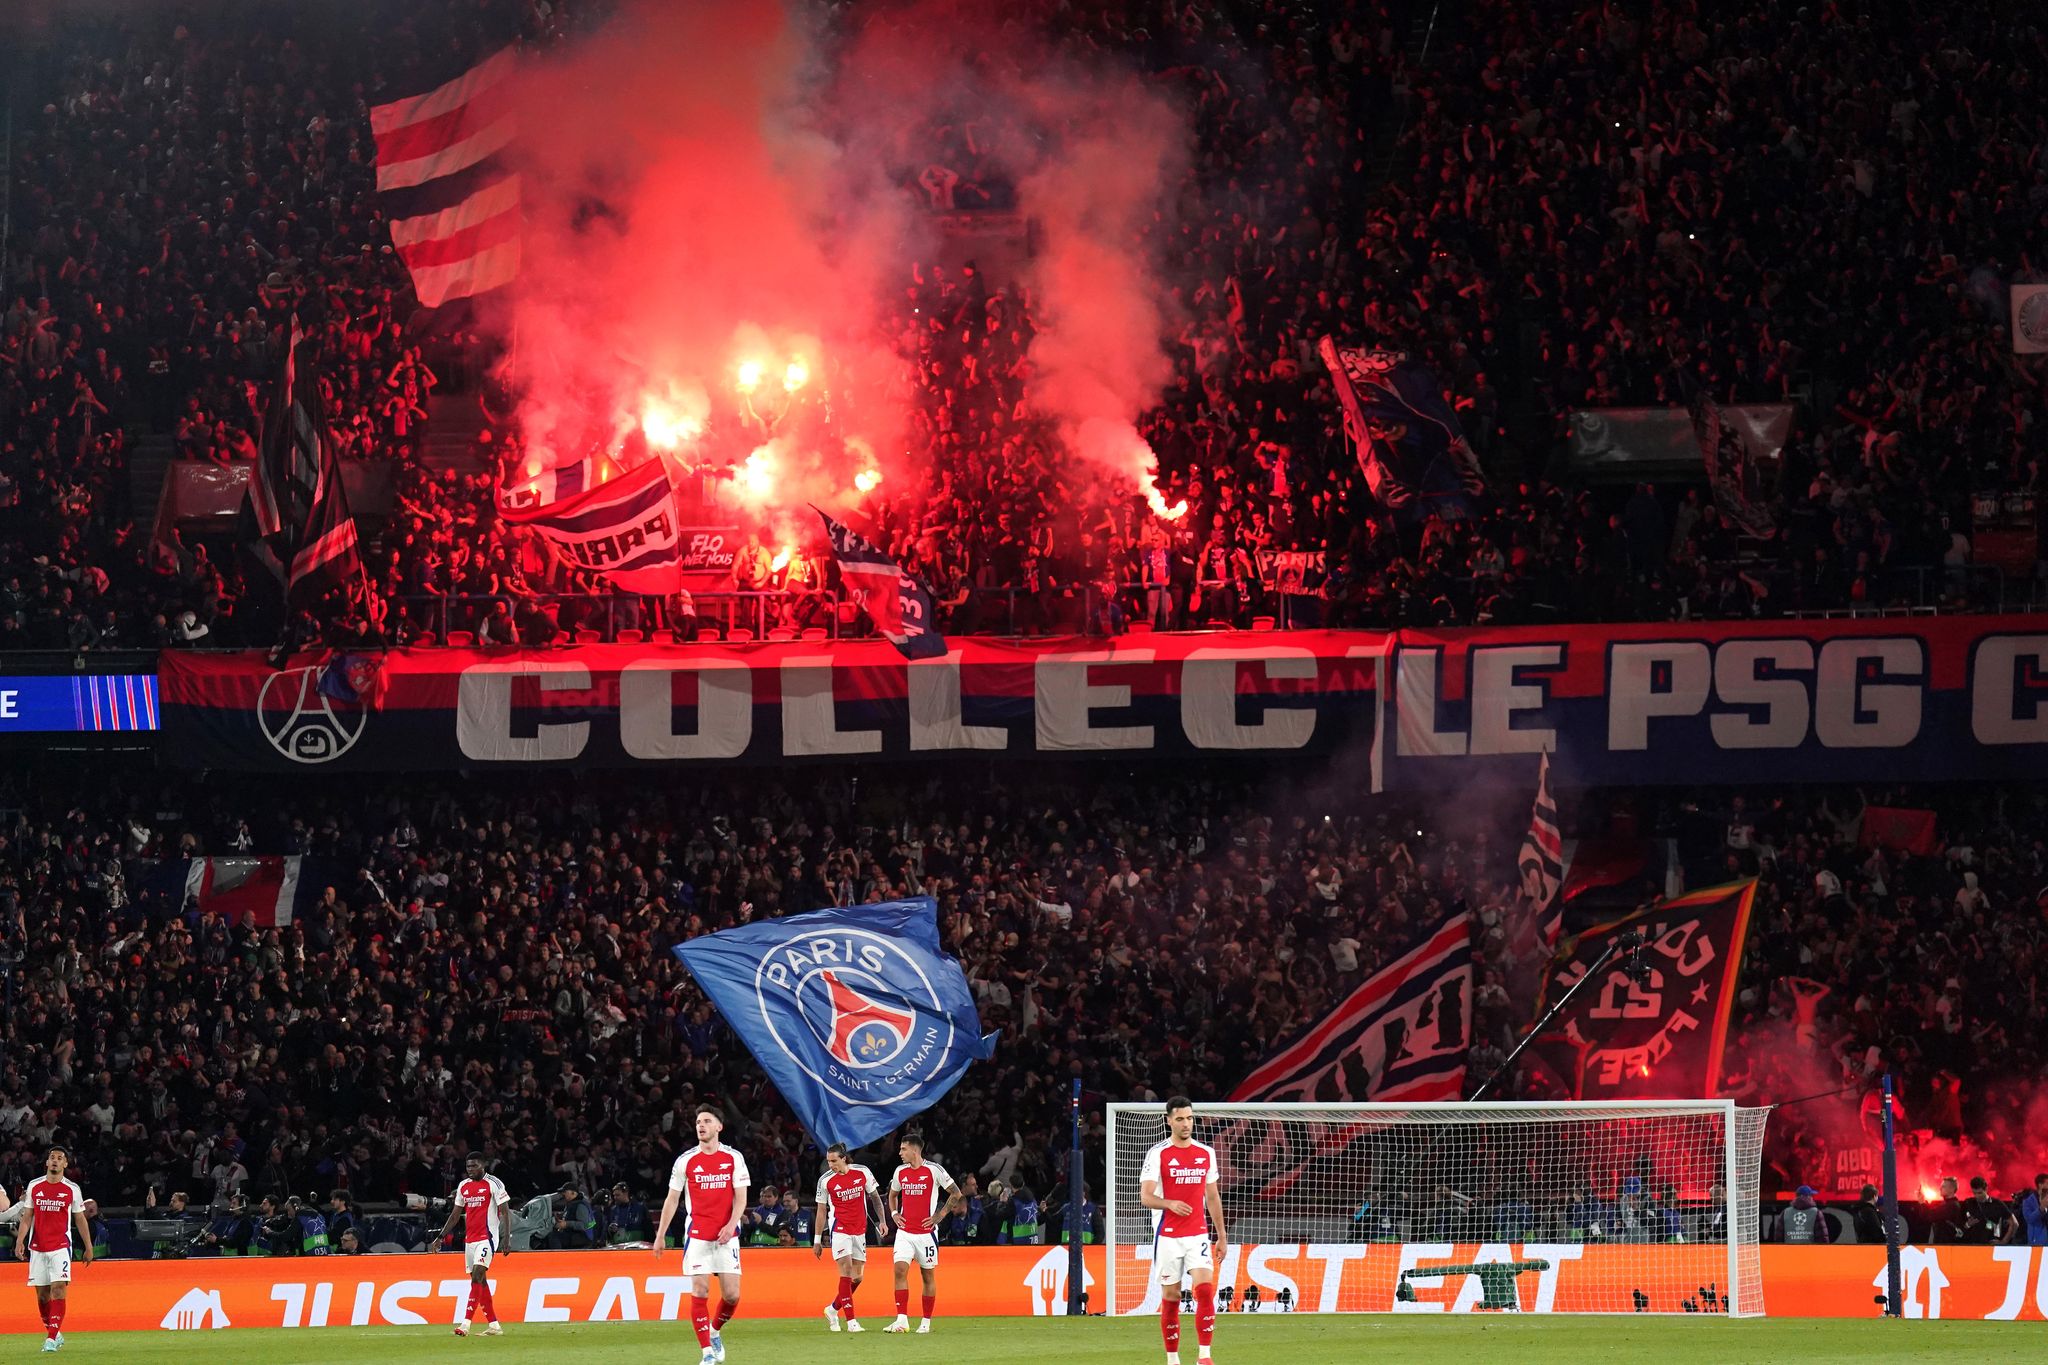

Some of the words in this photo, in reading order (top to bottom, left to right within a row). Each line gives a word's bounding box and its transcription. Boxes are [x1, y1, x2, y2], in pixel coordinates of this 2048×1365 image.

[690, 534, 724, 553] FLO
[705, 552, 734, 567] NOUS
[1261, 552, 1326, 574] PARIS
[1396, 644, 1560, 756] LE
[1607, 637, 1923, 751] PSG
[766, 938, 886, 990] PARIS
[827, 1064, 871, 1092] SAINT
[884, 1026, 939, 1086] GERMAIN
[1836, 1148, 1873, 1173] ABO
[695, 1173, 731, 1183] Emirates
[1169, 1167, 1206, 1177] Emirates
[700, 1182, 708, 1190] FLY
[708, 1181, 727, 1190] BETTER
[1175, 1176, 1184, 1185] FLY
[1184, 1176, 1202, 1184] BETTER
[1837, 1174, 1866, 1191] AVEC
[836, 1185, 864, 1198] Emirates
[36, 1198, 66, 1207] Emirates
[481, 1247, 488, 1258] 5
[924, 1245, 935, 1258] 15
[62, 1260, 69, 1273] 2
[1390, 1243, 1583, 1314] EAT
[524, 1276, 692, 1323] EAT
